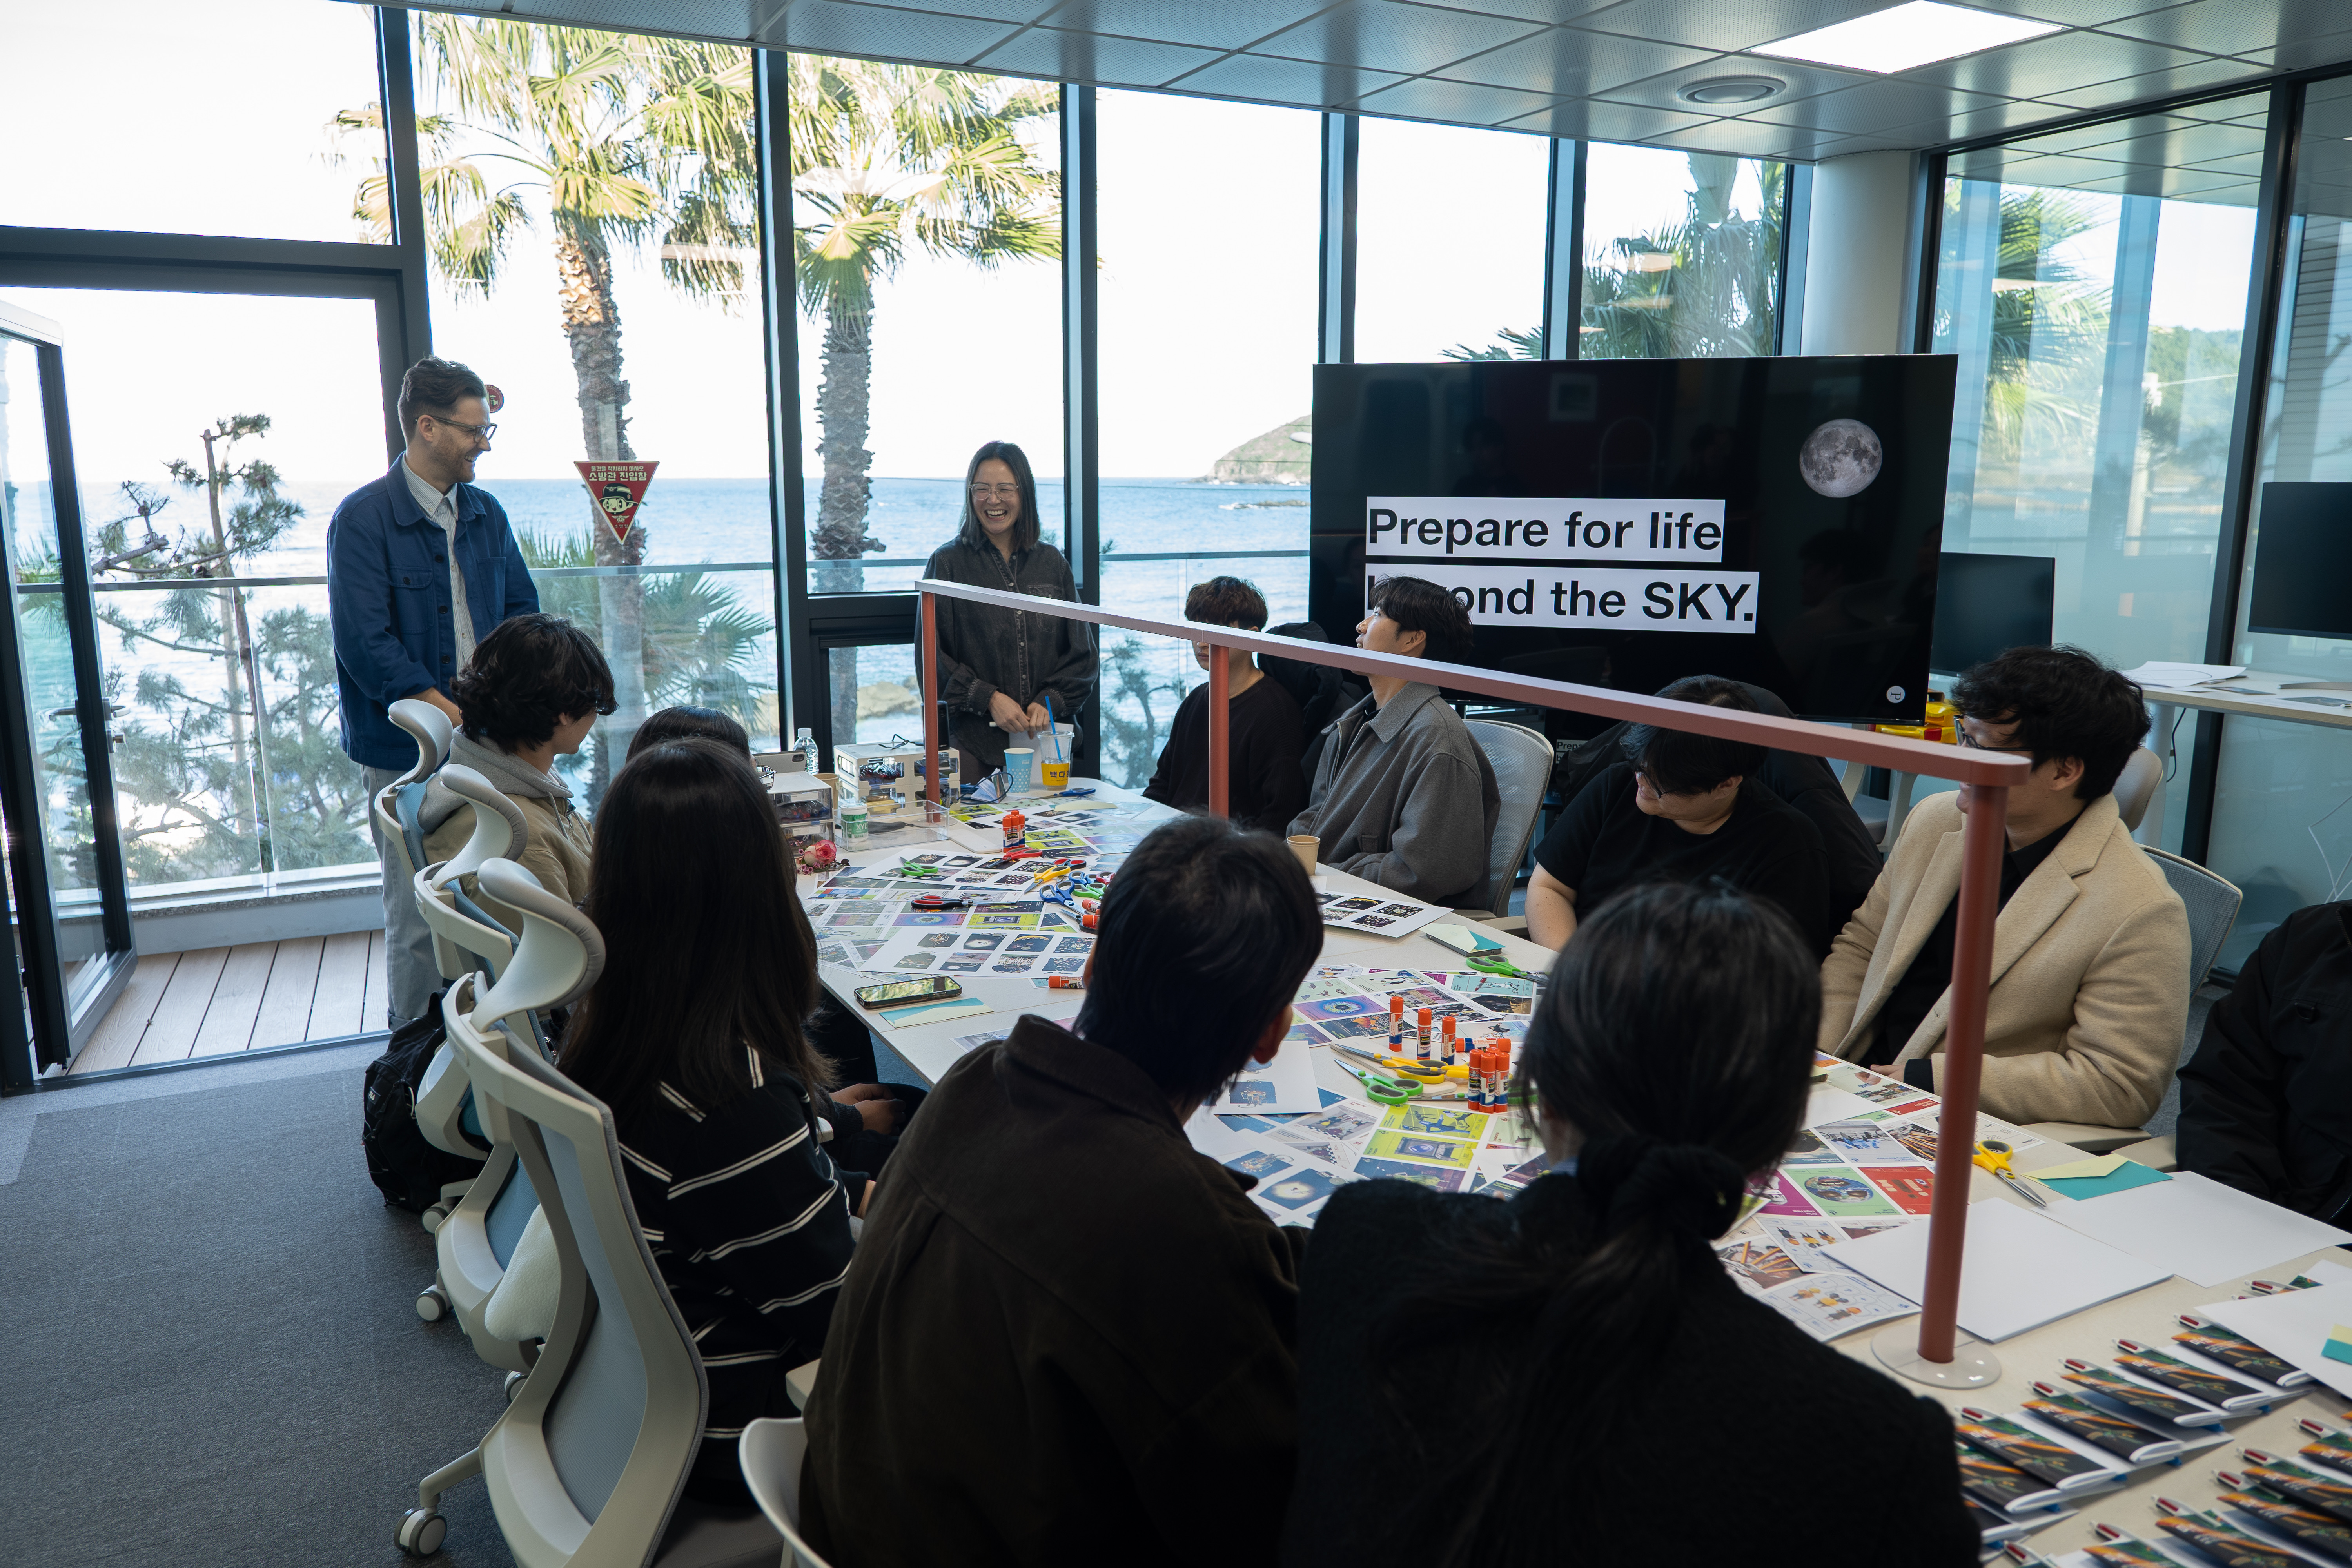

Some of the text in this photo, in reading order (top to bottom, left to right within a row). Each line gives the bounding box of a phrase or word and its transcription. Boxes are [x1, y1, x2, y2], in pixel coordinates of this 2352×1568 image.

[589, 472, 647, 481] 소방관 진입창
[1369, 508, 1721, 554] Prepare for life
[1367, 575, 1753, 622] ond the SKY.
[1557, 742, 1582, 750] Prep
